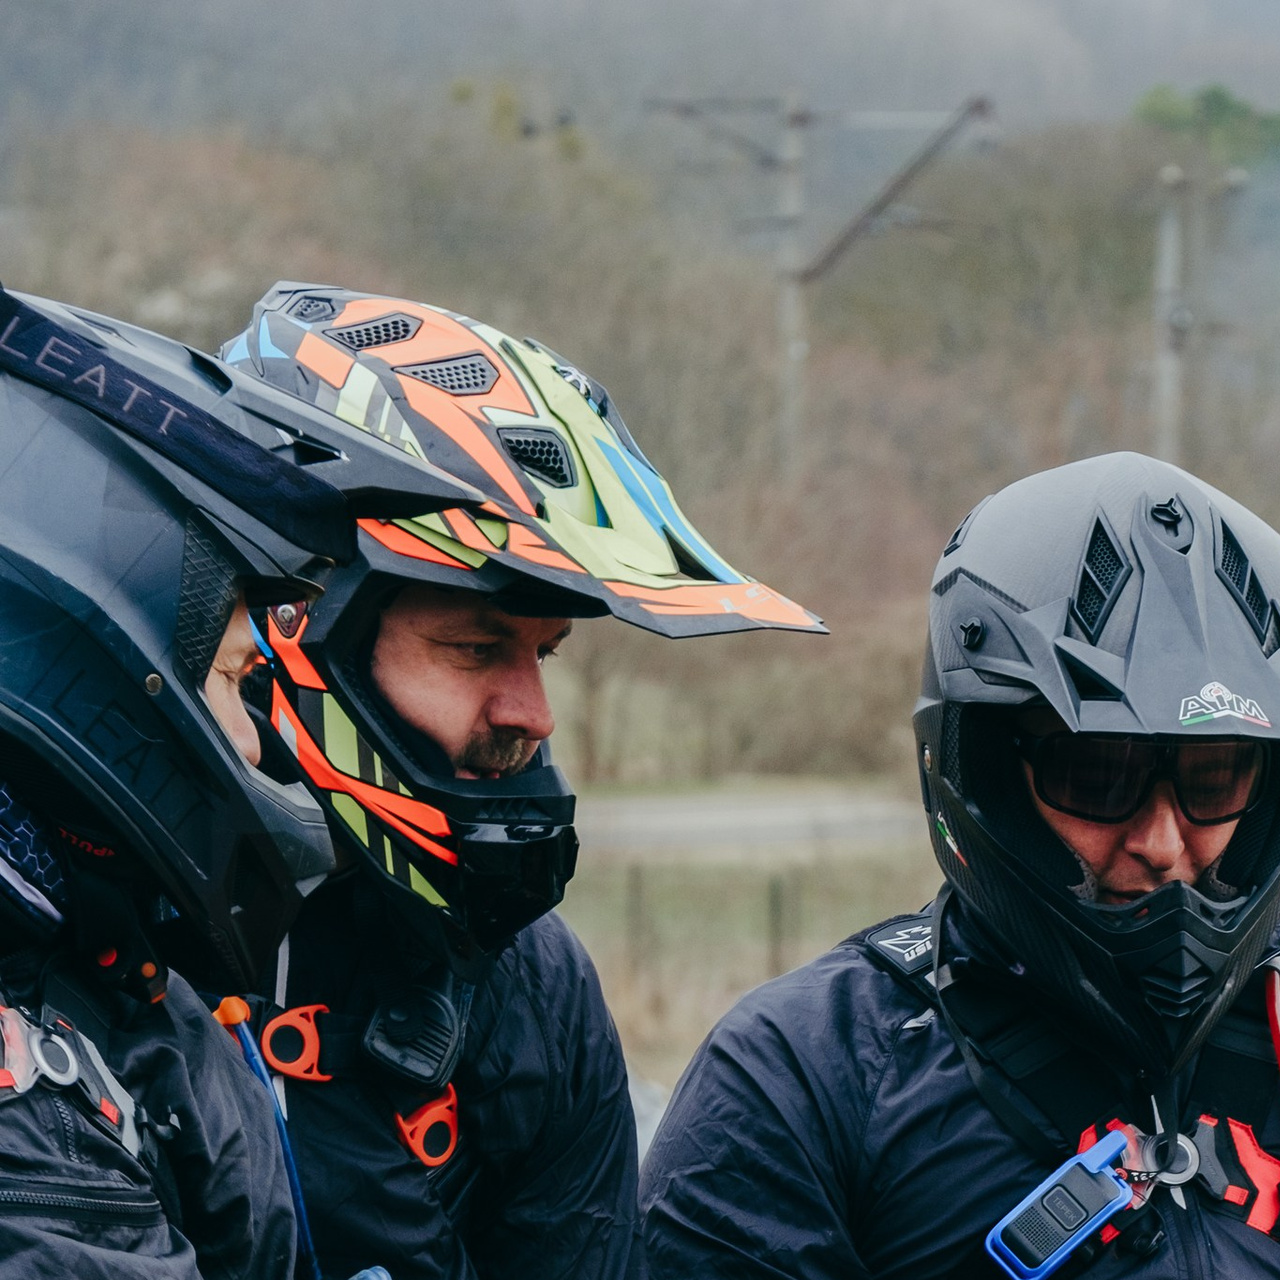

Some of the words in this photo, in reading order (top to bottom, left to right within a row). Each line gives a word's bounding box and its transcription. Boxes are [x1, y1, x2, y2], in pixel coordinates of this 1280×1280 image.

[0, 315, 189, 436] LEATT
[51, 668, 217, 832] LEATT
[58, 827, 109, 858] PULL
